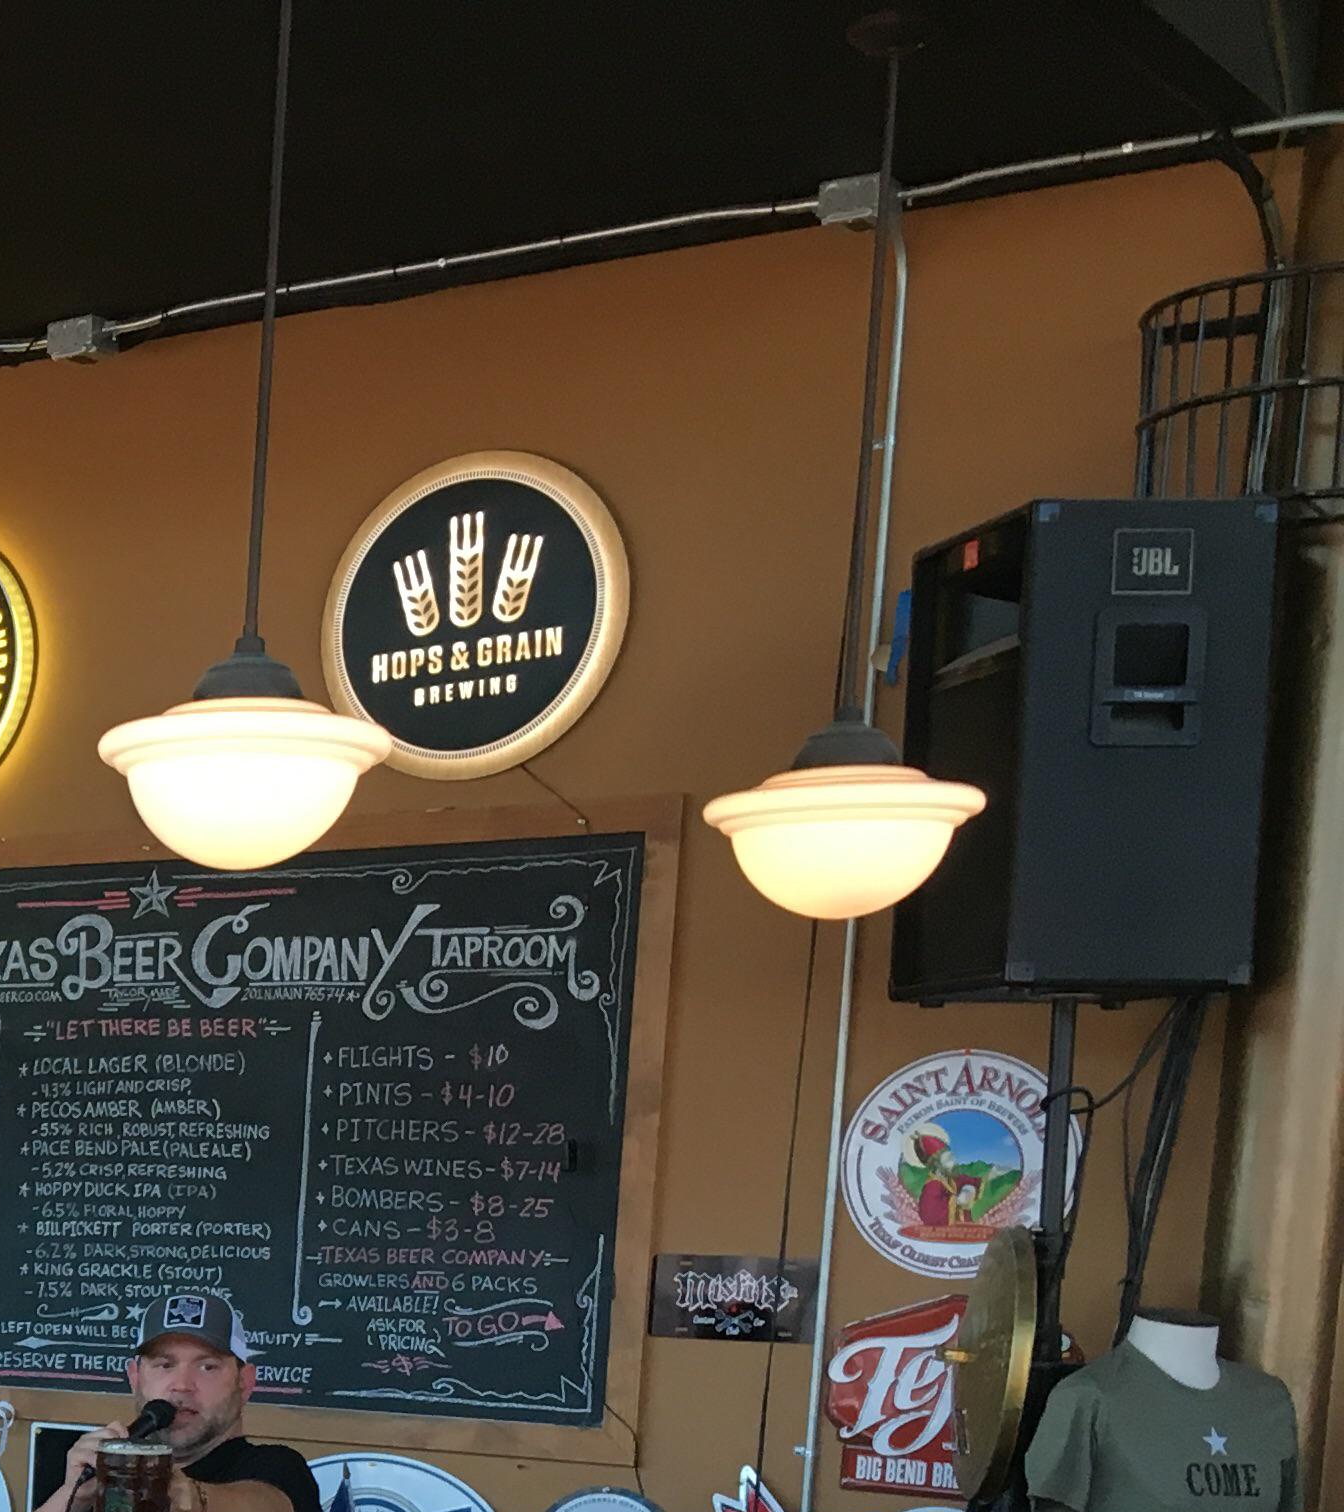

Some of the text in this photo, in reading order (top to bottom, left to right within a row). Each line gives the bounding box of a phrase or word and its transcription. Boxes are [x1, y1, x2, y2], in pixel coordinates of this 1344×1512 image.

[1131, 546, 1180, 577] JBL
[371, 625, 564, 684] HOPS & GRAIN
[413, 673, 519, 707] BREWING
[98, 1017, 192, 1038] THERE BE
[33, 1050, 246, 1076] LOCAL LAGER (BLONDE)
[337, 1043, 509, 1071] FLIGHTS $10
[339, 1082, 413, 1107] PINTS
[861, 1057, 1049, 1147] SAINT ARNOL
[970, 1096, 987, 1109] OF
[178, 1122, 270, 1140] REFRESHING
[336, 1117, 460, 1143] PITCHERS
[32, 1140, 163, 1158] PACE BEND PALE
[127, 1164, 228, 1181] REFRESHING
[330, 1153, 399, 1176] TEXAS
[404, 1157, 483, 1179] WINES
[84, 1182, 162, 1198] DUCK IPA
[331, 1184, 444, 1213] BOMBERS
[131, 1221, 193, 1238] PORTER
[332, 1218, 401, 1240] CANS
[190, 1245, 271, 1260] DELICIOUS
[321, 1246, 545, 1268] TEXAS BEER COMPANY
[33, 1262, 152, 1280] KING GRACKLE
[318, 1273, 538, 1295] GROWLERS AND 6 PACKS
[345, 1295, 440, 1315] AVAILABLE!
[0, 1320, 129, 1338] LEFT OPEN WILL BE
[366, 1318, 427, 1335] ASK FOR
[441, 1311, 520, 1338] TO GO
[74, 1352, 105, 1371] THE
[855, 1455, 882, 1482] BIG
[885, 1458, 927, 1486] BEND
[1185, 1462, 1262, 1499] COME
